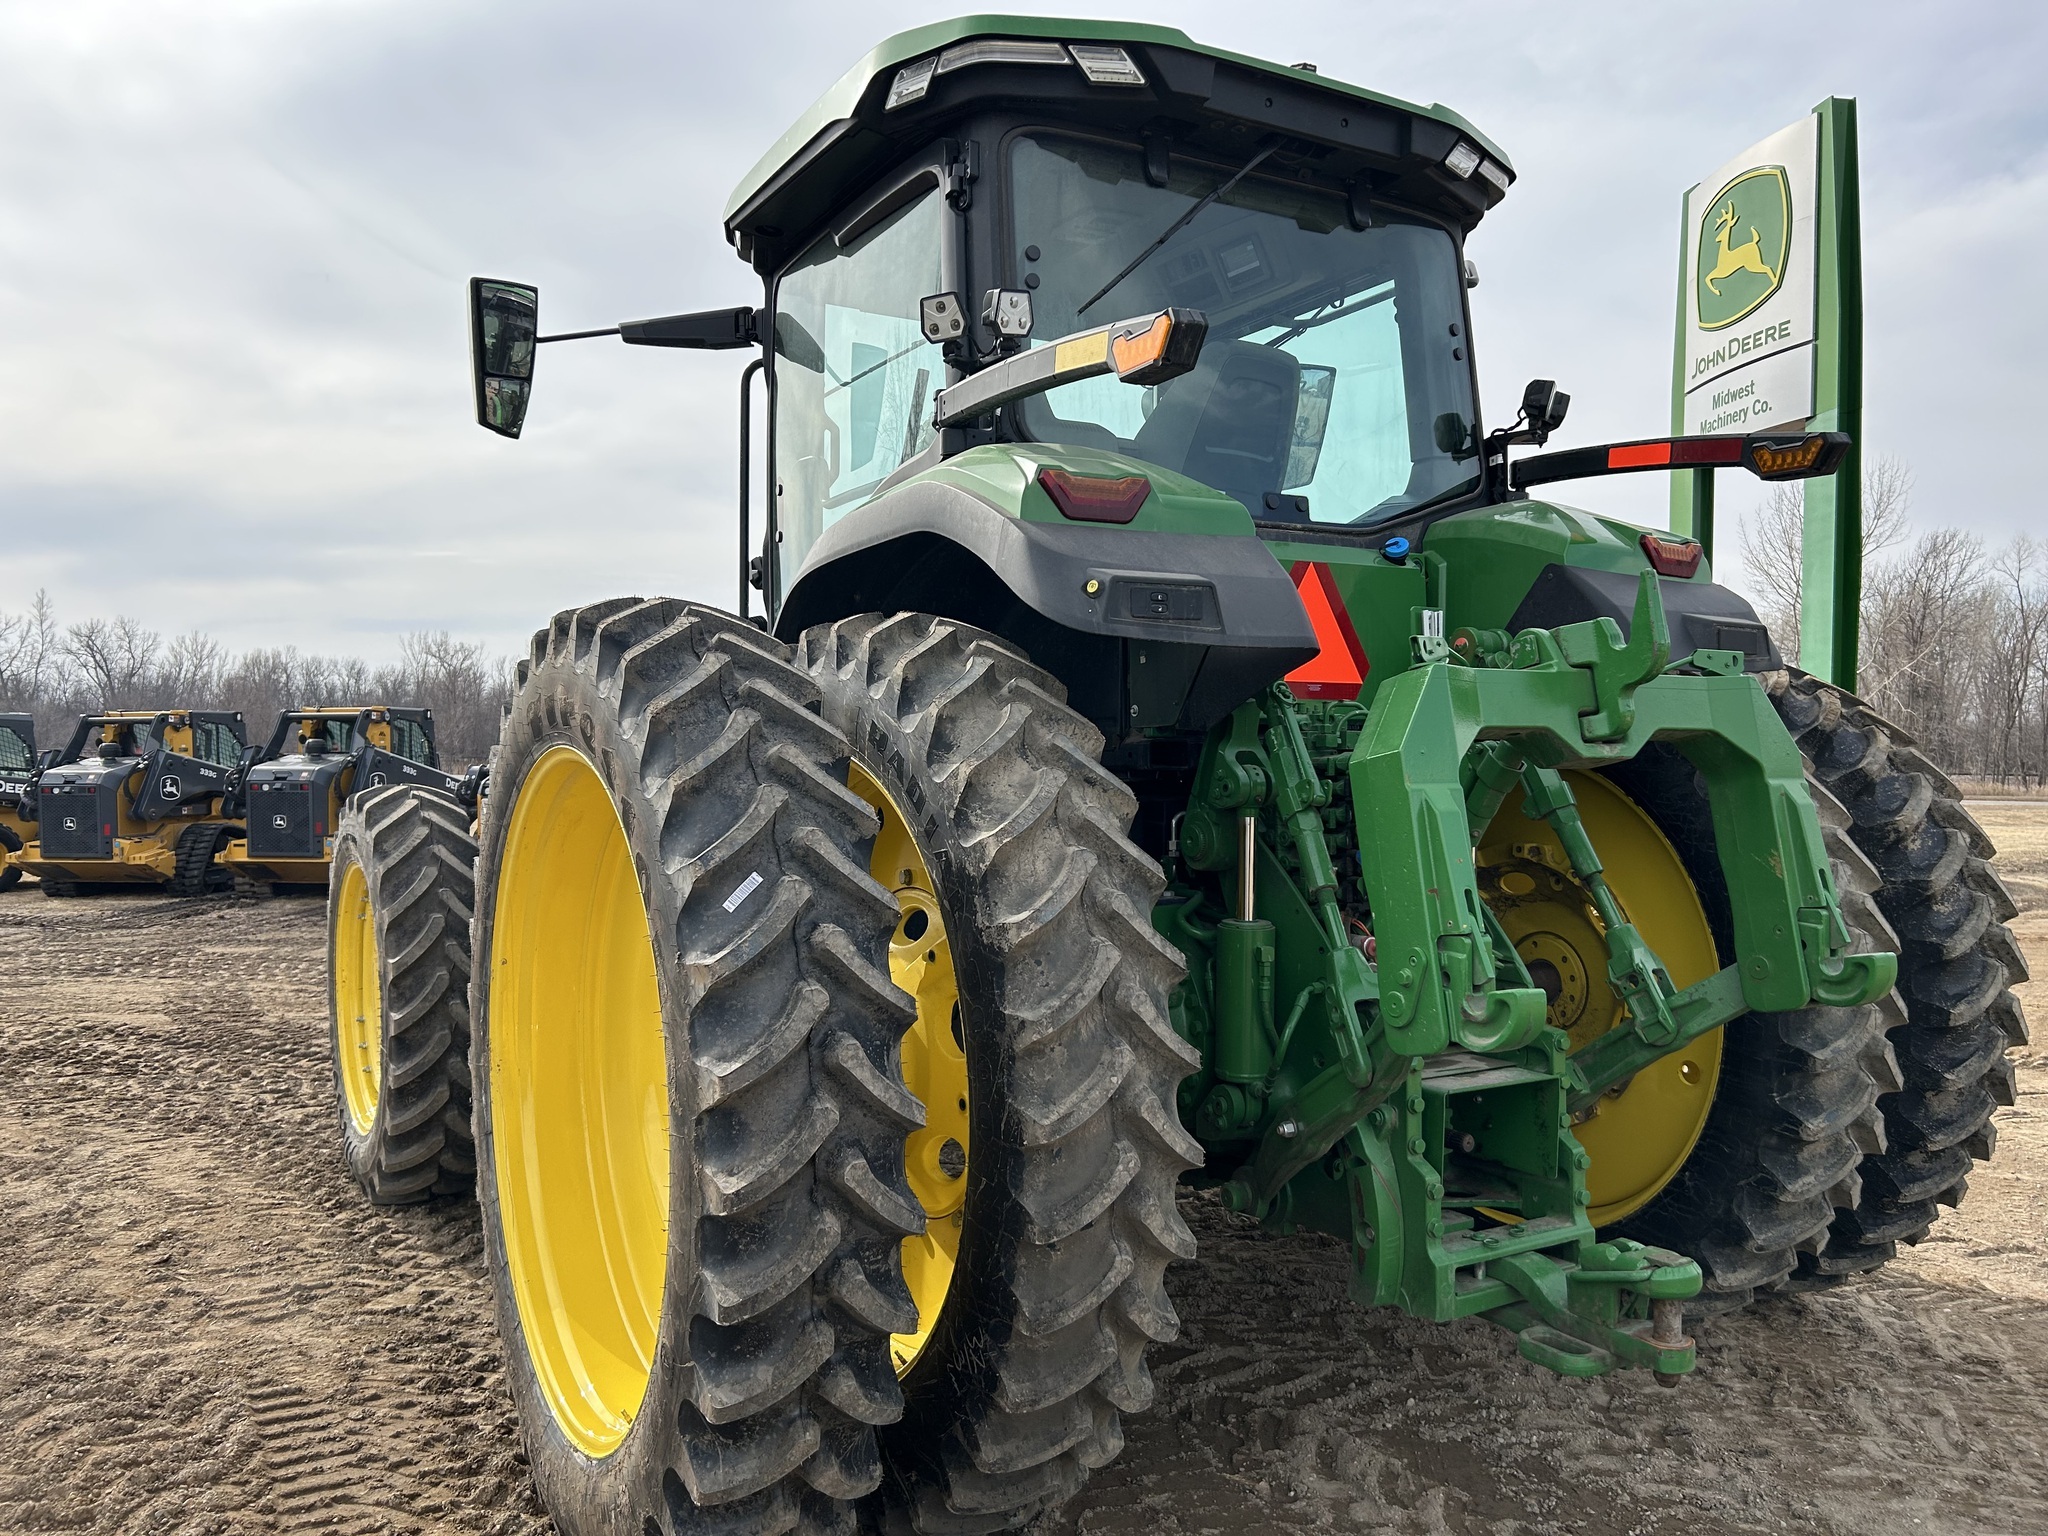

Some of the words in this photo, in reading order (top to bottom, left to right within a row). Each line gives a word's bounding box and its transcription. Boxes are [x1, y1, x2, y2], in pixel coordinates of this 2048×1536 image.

[1692, 346, 1726, 379] JOHN
[1728, 319, 1791, 360] DEERE
[1712, 379, 1755, 411] Midwest
[1700, 406, 1749, 435] Machinery
[1752, 399, 1773, 416] Co.
[200, 767, 217, 778] 333G
